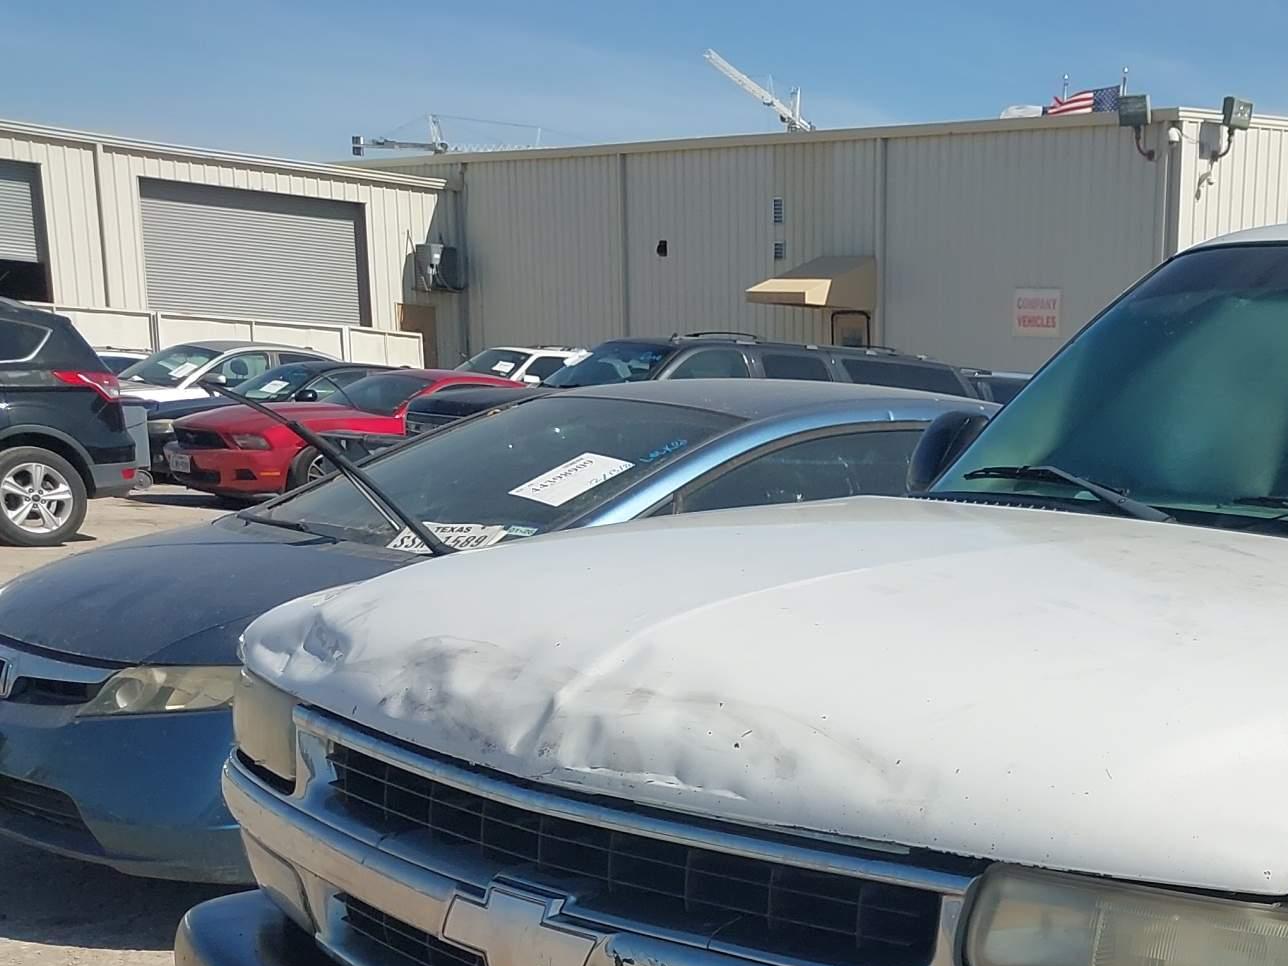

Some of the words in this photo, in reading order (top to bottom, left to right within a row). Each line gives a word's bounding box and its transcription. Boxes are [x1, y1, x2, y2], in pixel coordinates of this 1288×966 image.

[1017, 297, 1057, 310] COMPANY
[1017, 315, 1057, 328] VEHICLES
[443, 535, 488, 548] 1589
